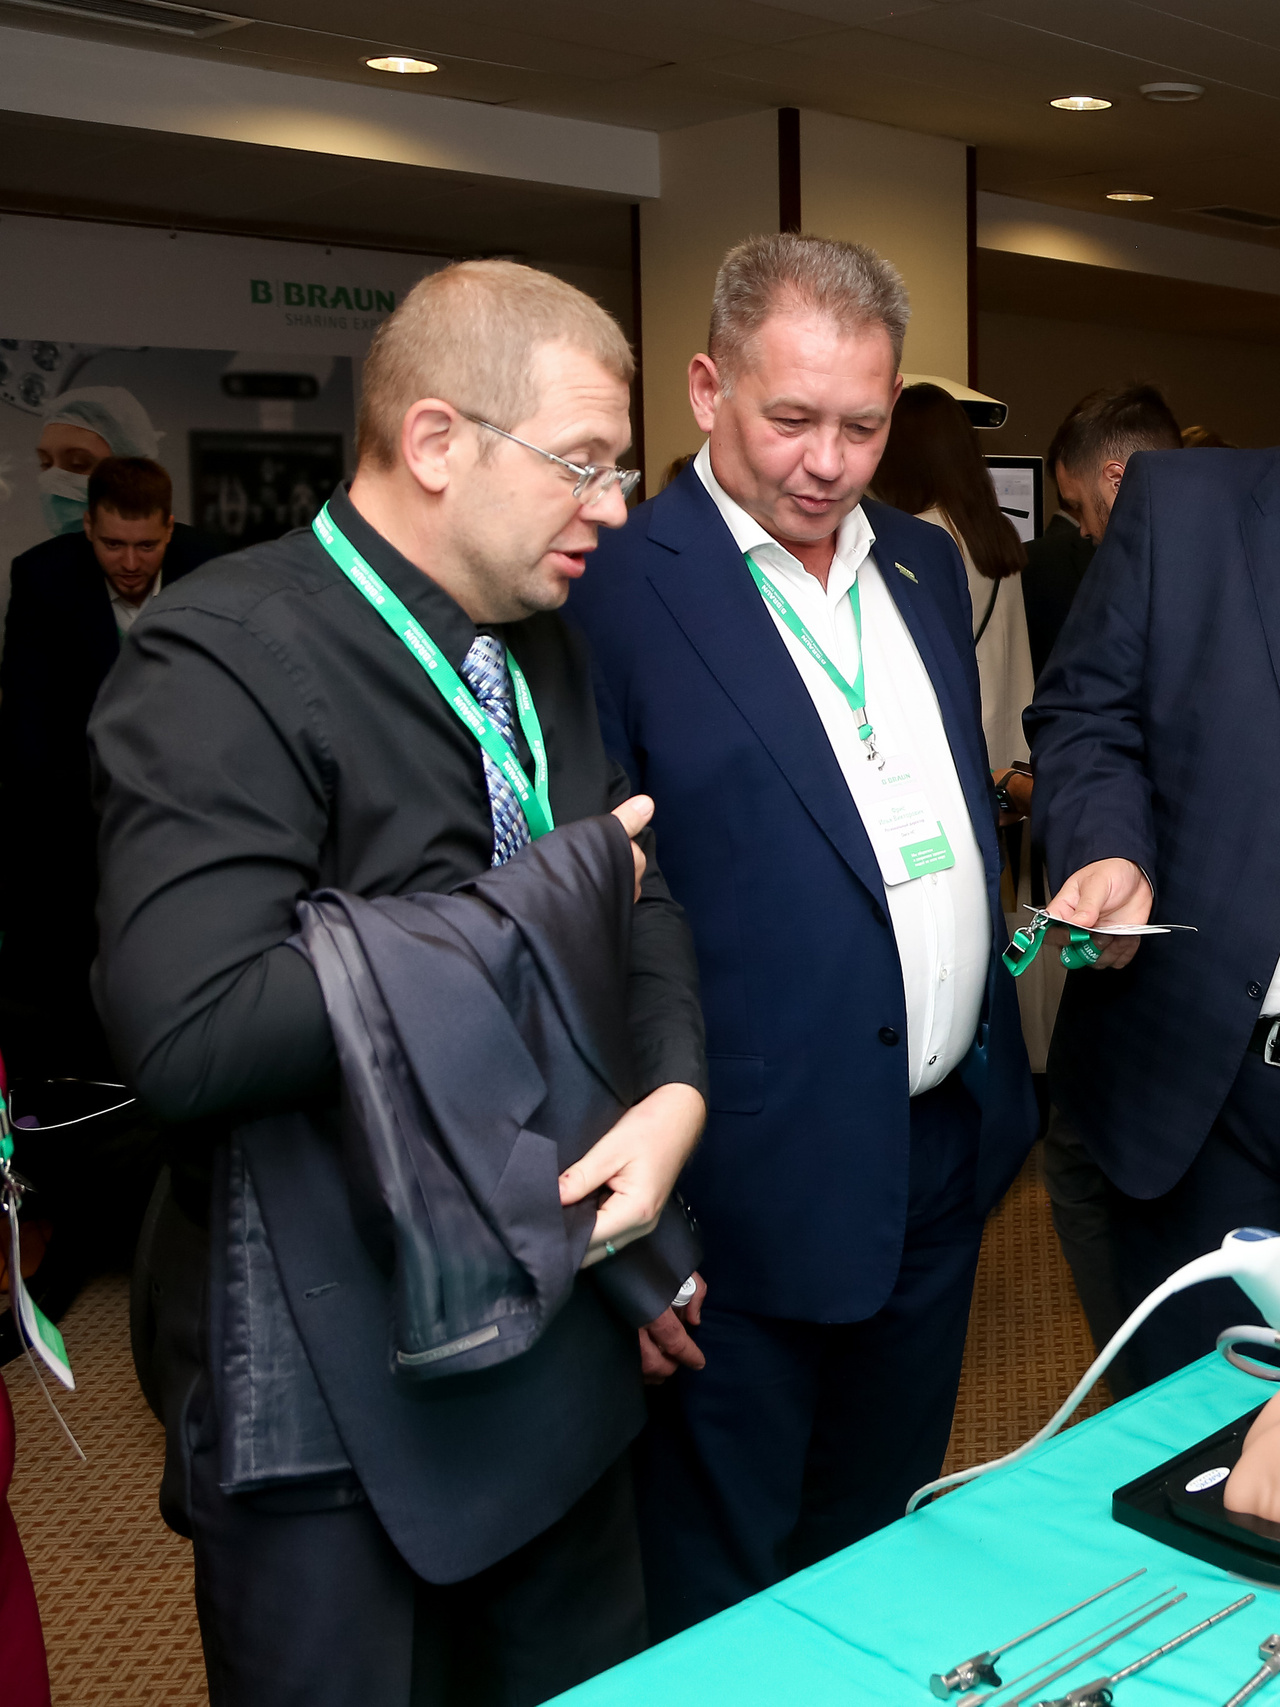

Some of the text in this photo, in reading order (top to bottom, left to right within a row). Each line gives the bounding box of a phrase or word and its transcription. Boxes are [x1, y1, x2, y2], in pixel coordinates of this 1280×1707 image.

[250, 279, 396, 313] B BRAUN
[285, 313, 347, 330] SHARING
[761, 584, 783, 610] BRAUN
[403, 628, 432, 662] BRAUN
[801, 634, 821, 660] BRAUN
[519, 677, 531, 710] BRAUN
[453, 695, 480, 728] BRAUN
[502, 759, 524, 795] BRAUN
